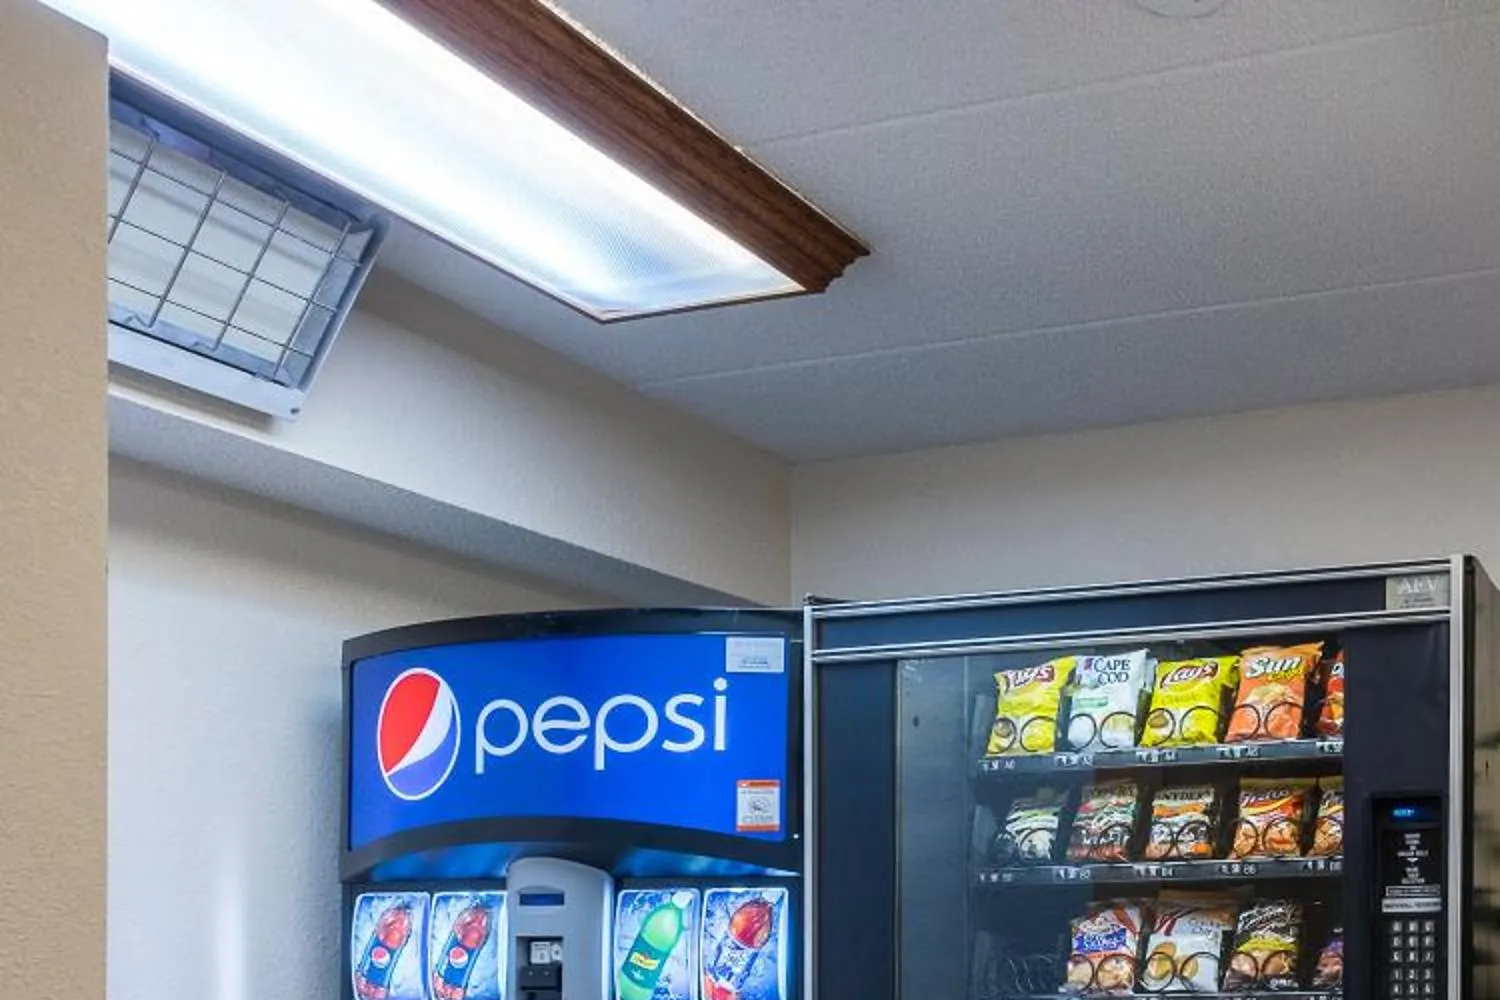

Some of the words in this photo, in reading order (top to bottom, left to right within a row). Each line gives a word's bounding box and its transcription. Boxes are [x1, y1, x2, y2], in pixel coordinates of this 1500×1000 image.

[1093, 657, 1131, 671] CAPE
[1246, 656, 1302, 678] Sun
[1097, 671, 1130, 686] COD
[475, 677, 728, 775] pepsi
